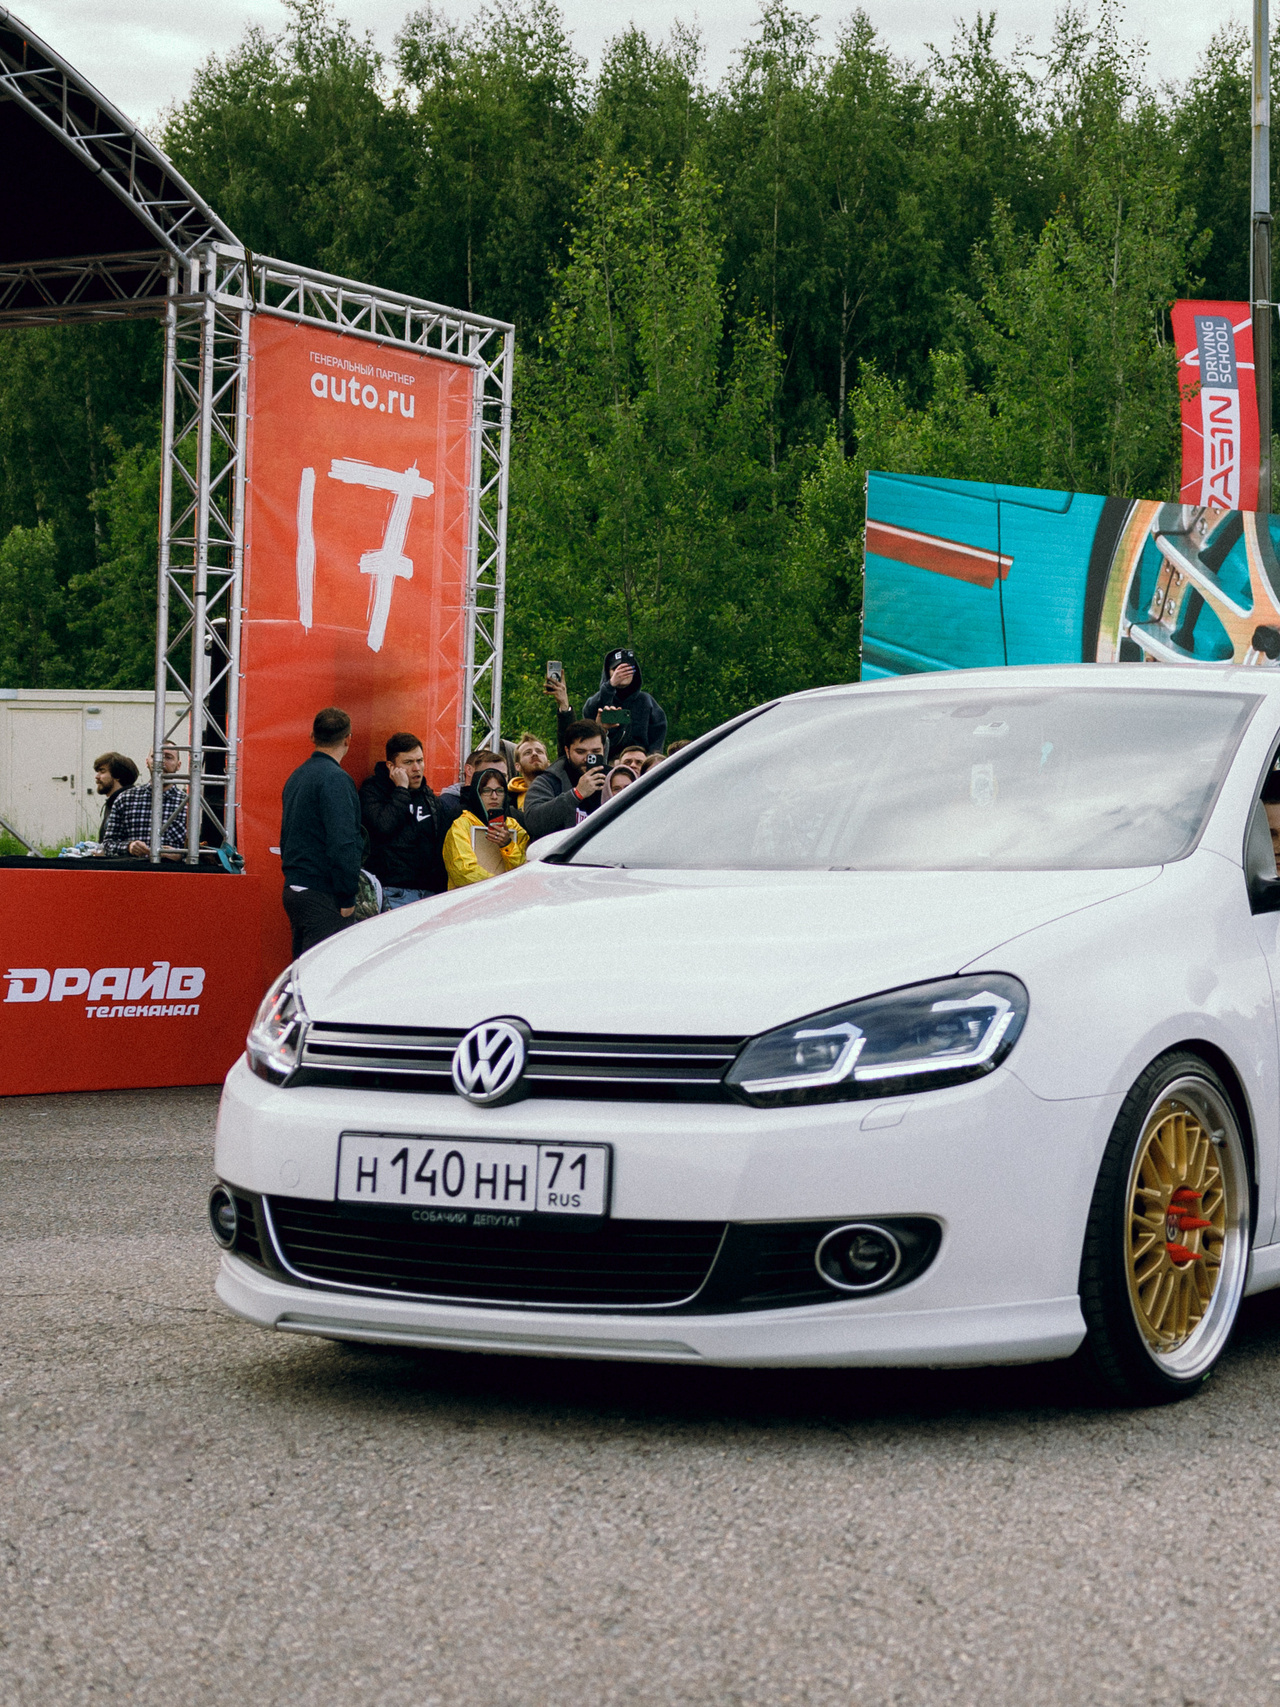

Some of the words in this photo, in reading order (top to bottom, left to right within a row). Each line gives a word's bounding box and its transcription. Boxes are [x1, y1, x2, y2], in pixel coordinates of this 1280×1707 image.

[309, 351, 374, 377] ГЕНЕРАЛЬНЫЙ
[375, 367, 415, 386] ПАРТНЕР
[1201, 321, 1219, 382] DRIVING
[1215, 322, 1232, 383] SCHOOL
[310, 372, 415, 418] auto.ru
[296, 457, 435, 653] 17
[3, 961, 206, 1002] ДРАЙВ
[545, 1151, 587, 1191] 71
[473, 1213, 521, 1227] ДЕПУТАТ
[548, 1192, 581, 1208] RUS
